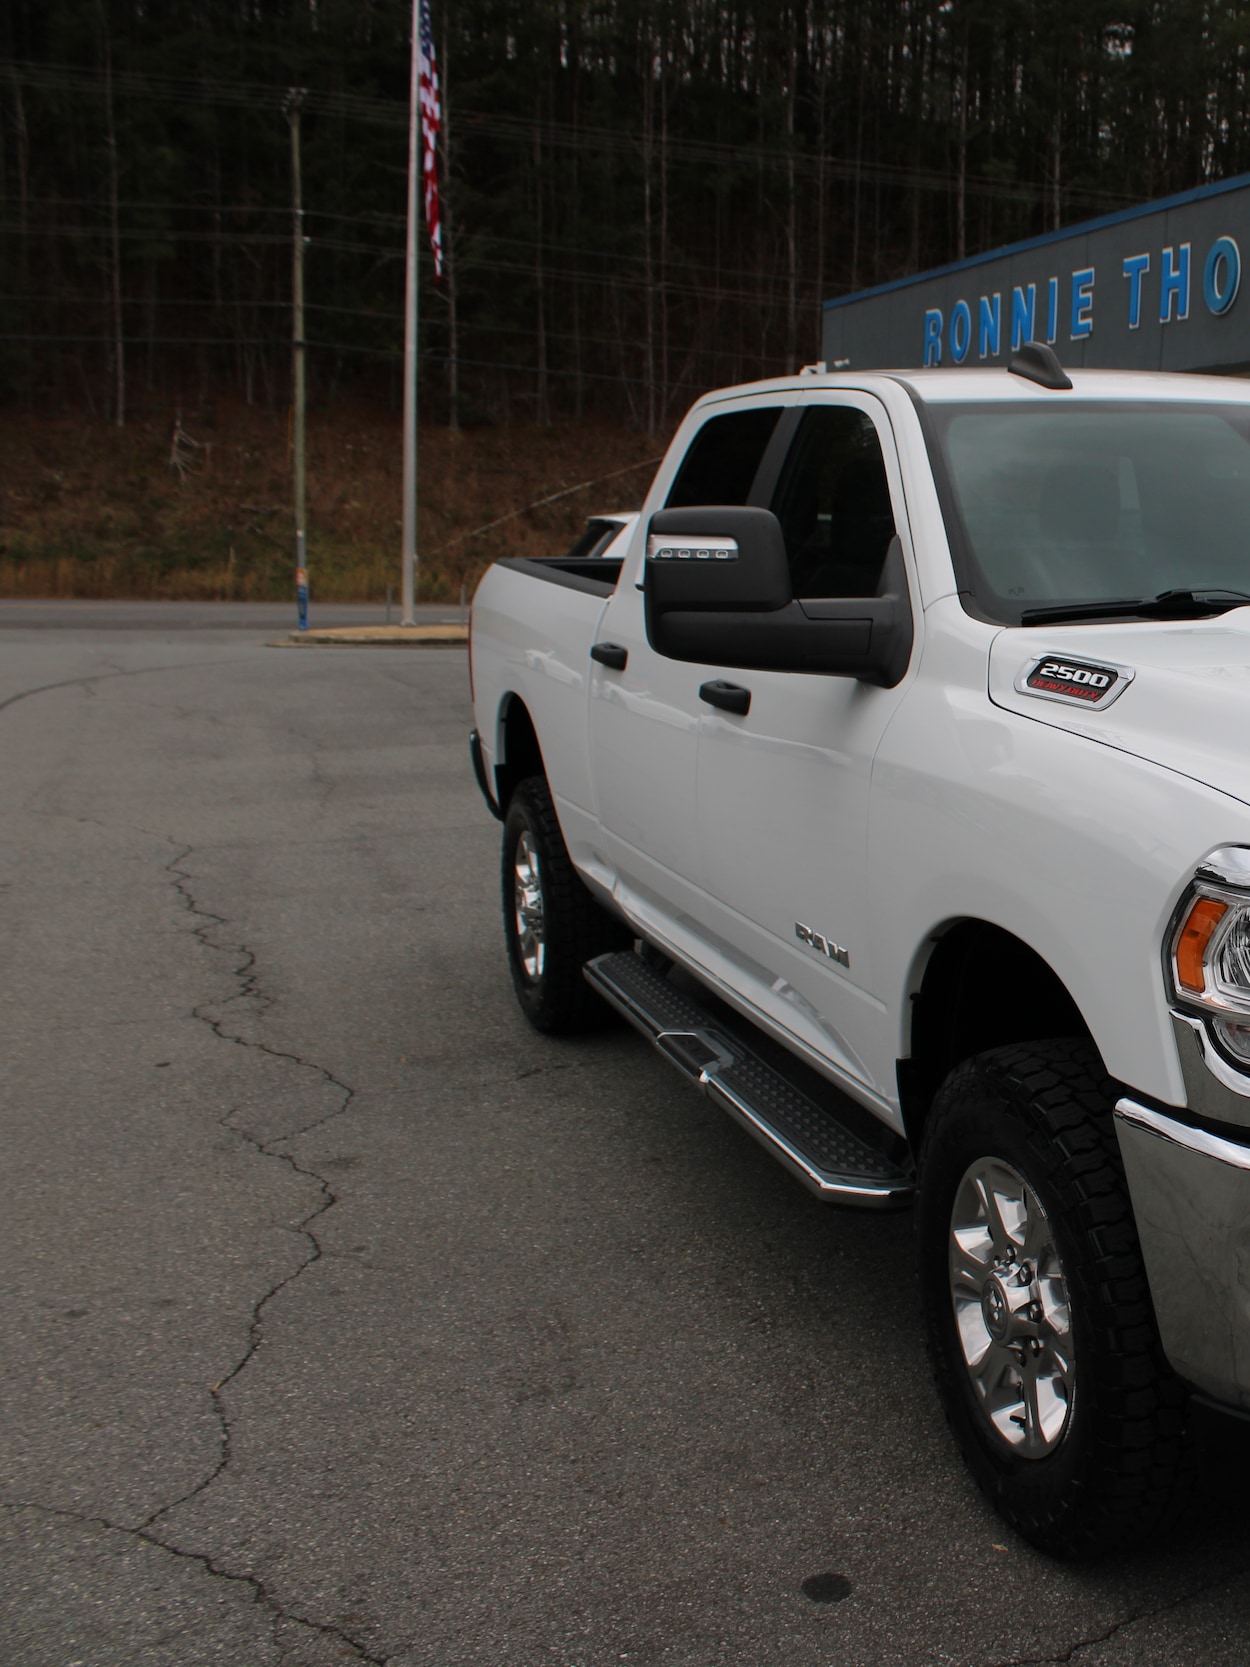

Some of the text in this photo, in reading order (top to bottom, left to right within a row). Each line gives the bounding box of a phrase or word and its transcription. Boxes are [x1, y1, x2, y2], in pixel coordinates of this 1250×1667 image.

[922, 267, 1096, 368] RONNIE
[1039, 662, 1110, 687] 2500
[1031, 678, 1100, 699] HEAVY DUTY
